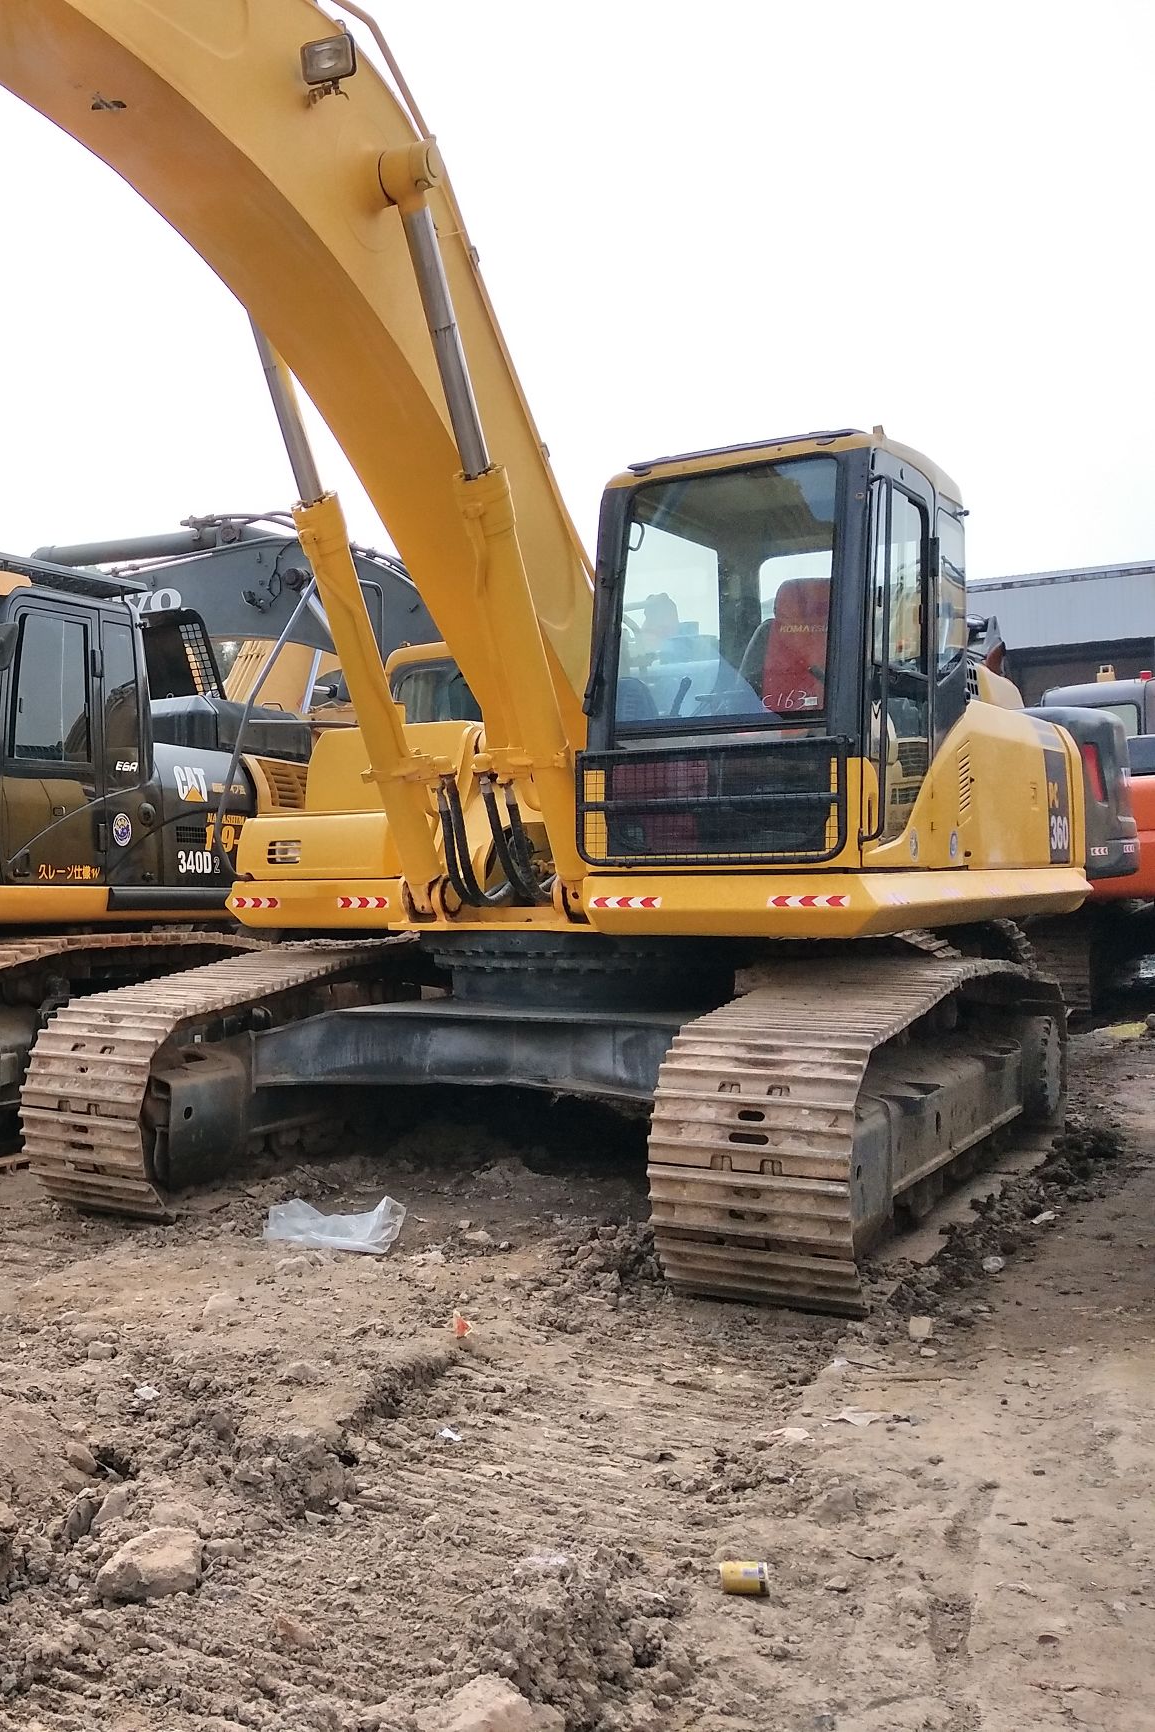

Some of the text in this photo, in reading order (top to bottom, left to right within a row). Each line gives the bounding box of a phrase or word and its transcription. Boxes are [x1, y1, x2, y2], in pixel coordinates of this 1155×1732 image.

[173, 765, 208, 802] CAT
[1050, 815, 1068, 850] 360
[177, 850, 212, 874] 340D
